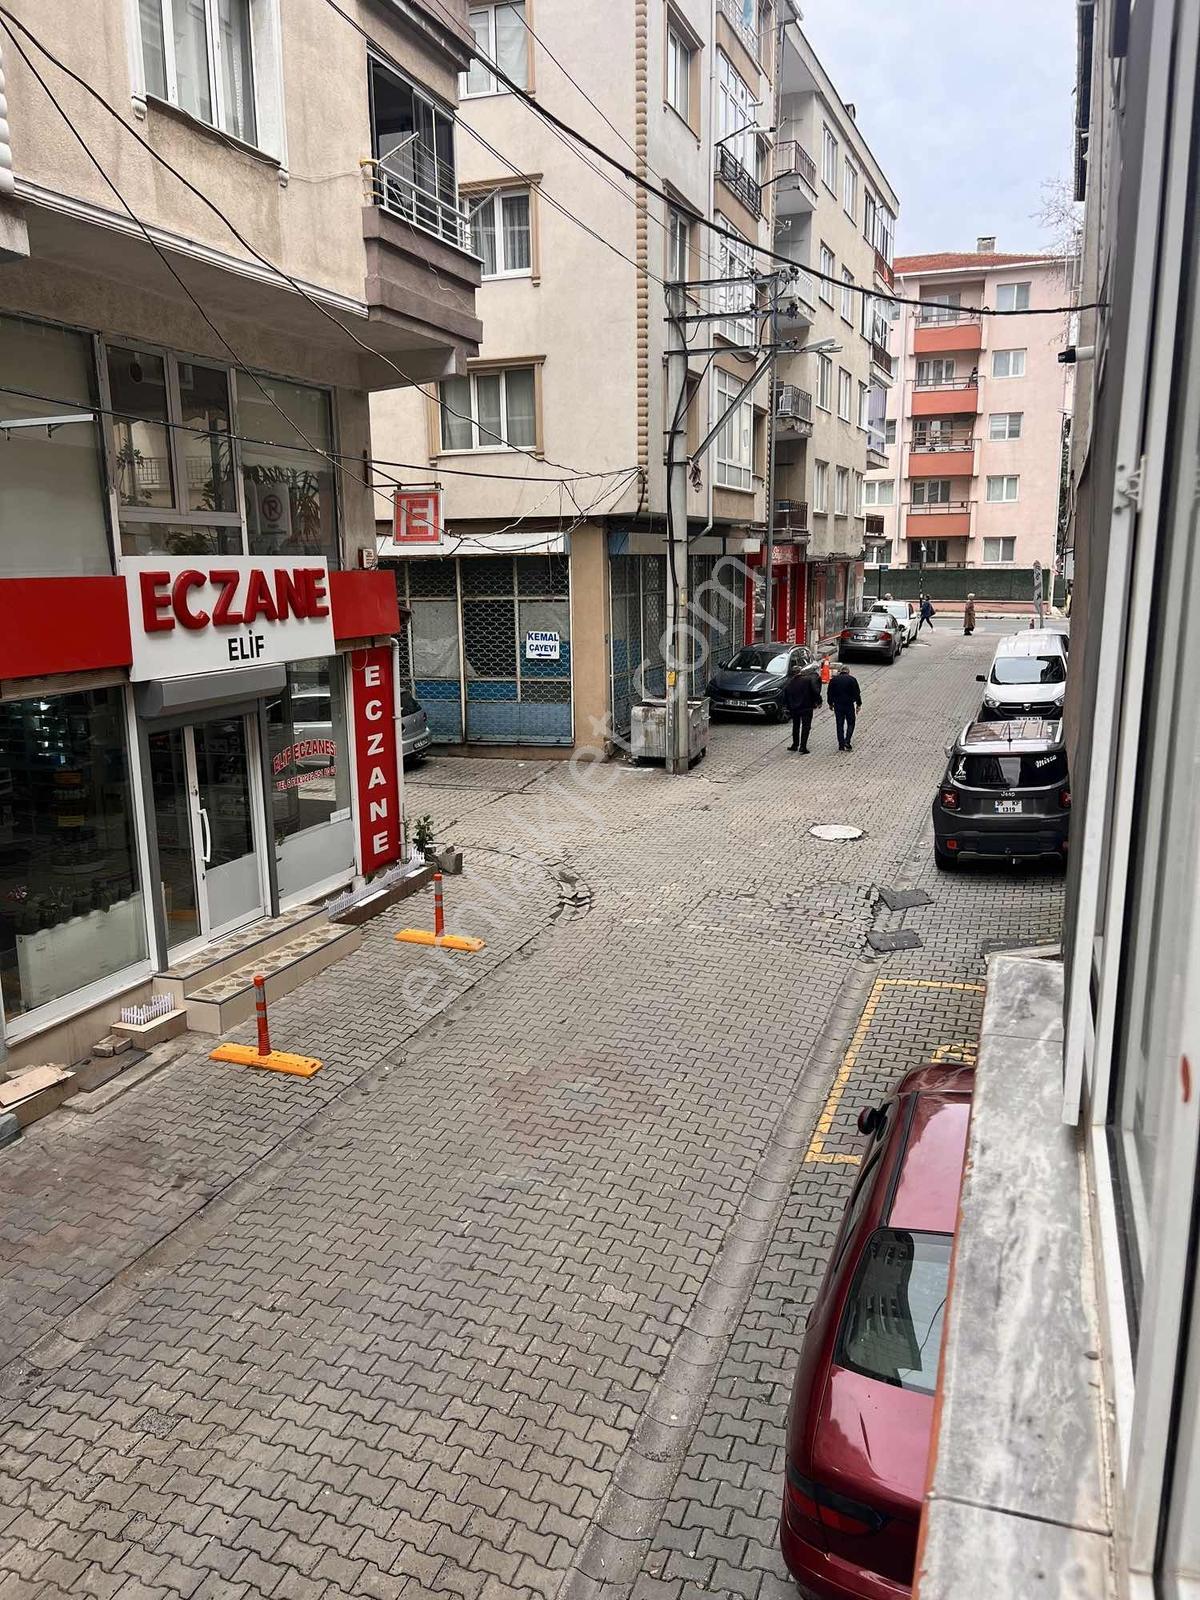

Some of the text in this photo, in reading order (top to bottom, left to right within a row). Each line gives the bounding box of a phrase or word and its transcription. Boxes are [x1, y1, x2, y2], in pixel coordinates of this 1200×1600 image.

[139, 568, 330, 633] ECZANE
[228, 629, 265, 661] ELİF
[527, 632, 559, 642] KEMAL
[364, 665, 389, 855] ECZANE
